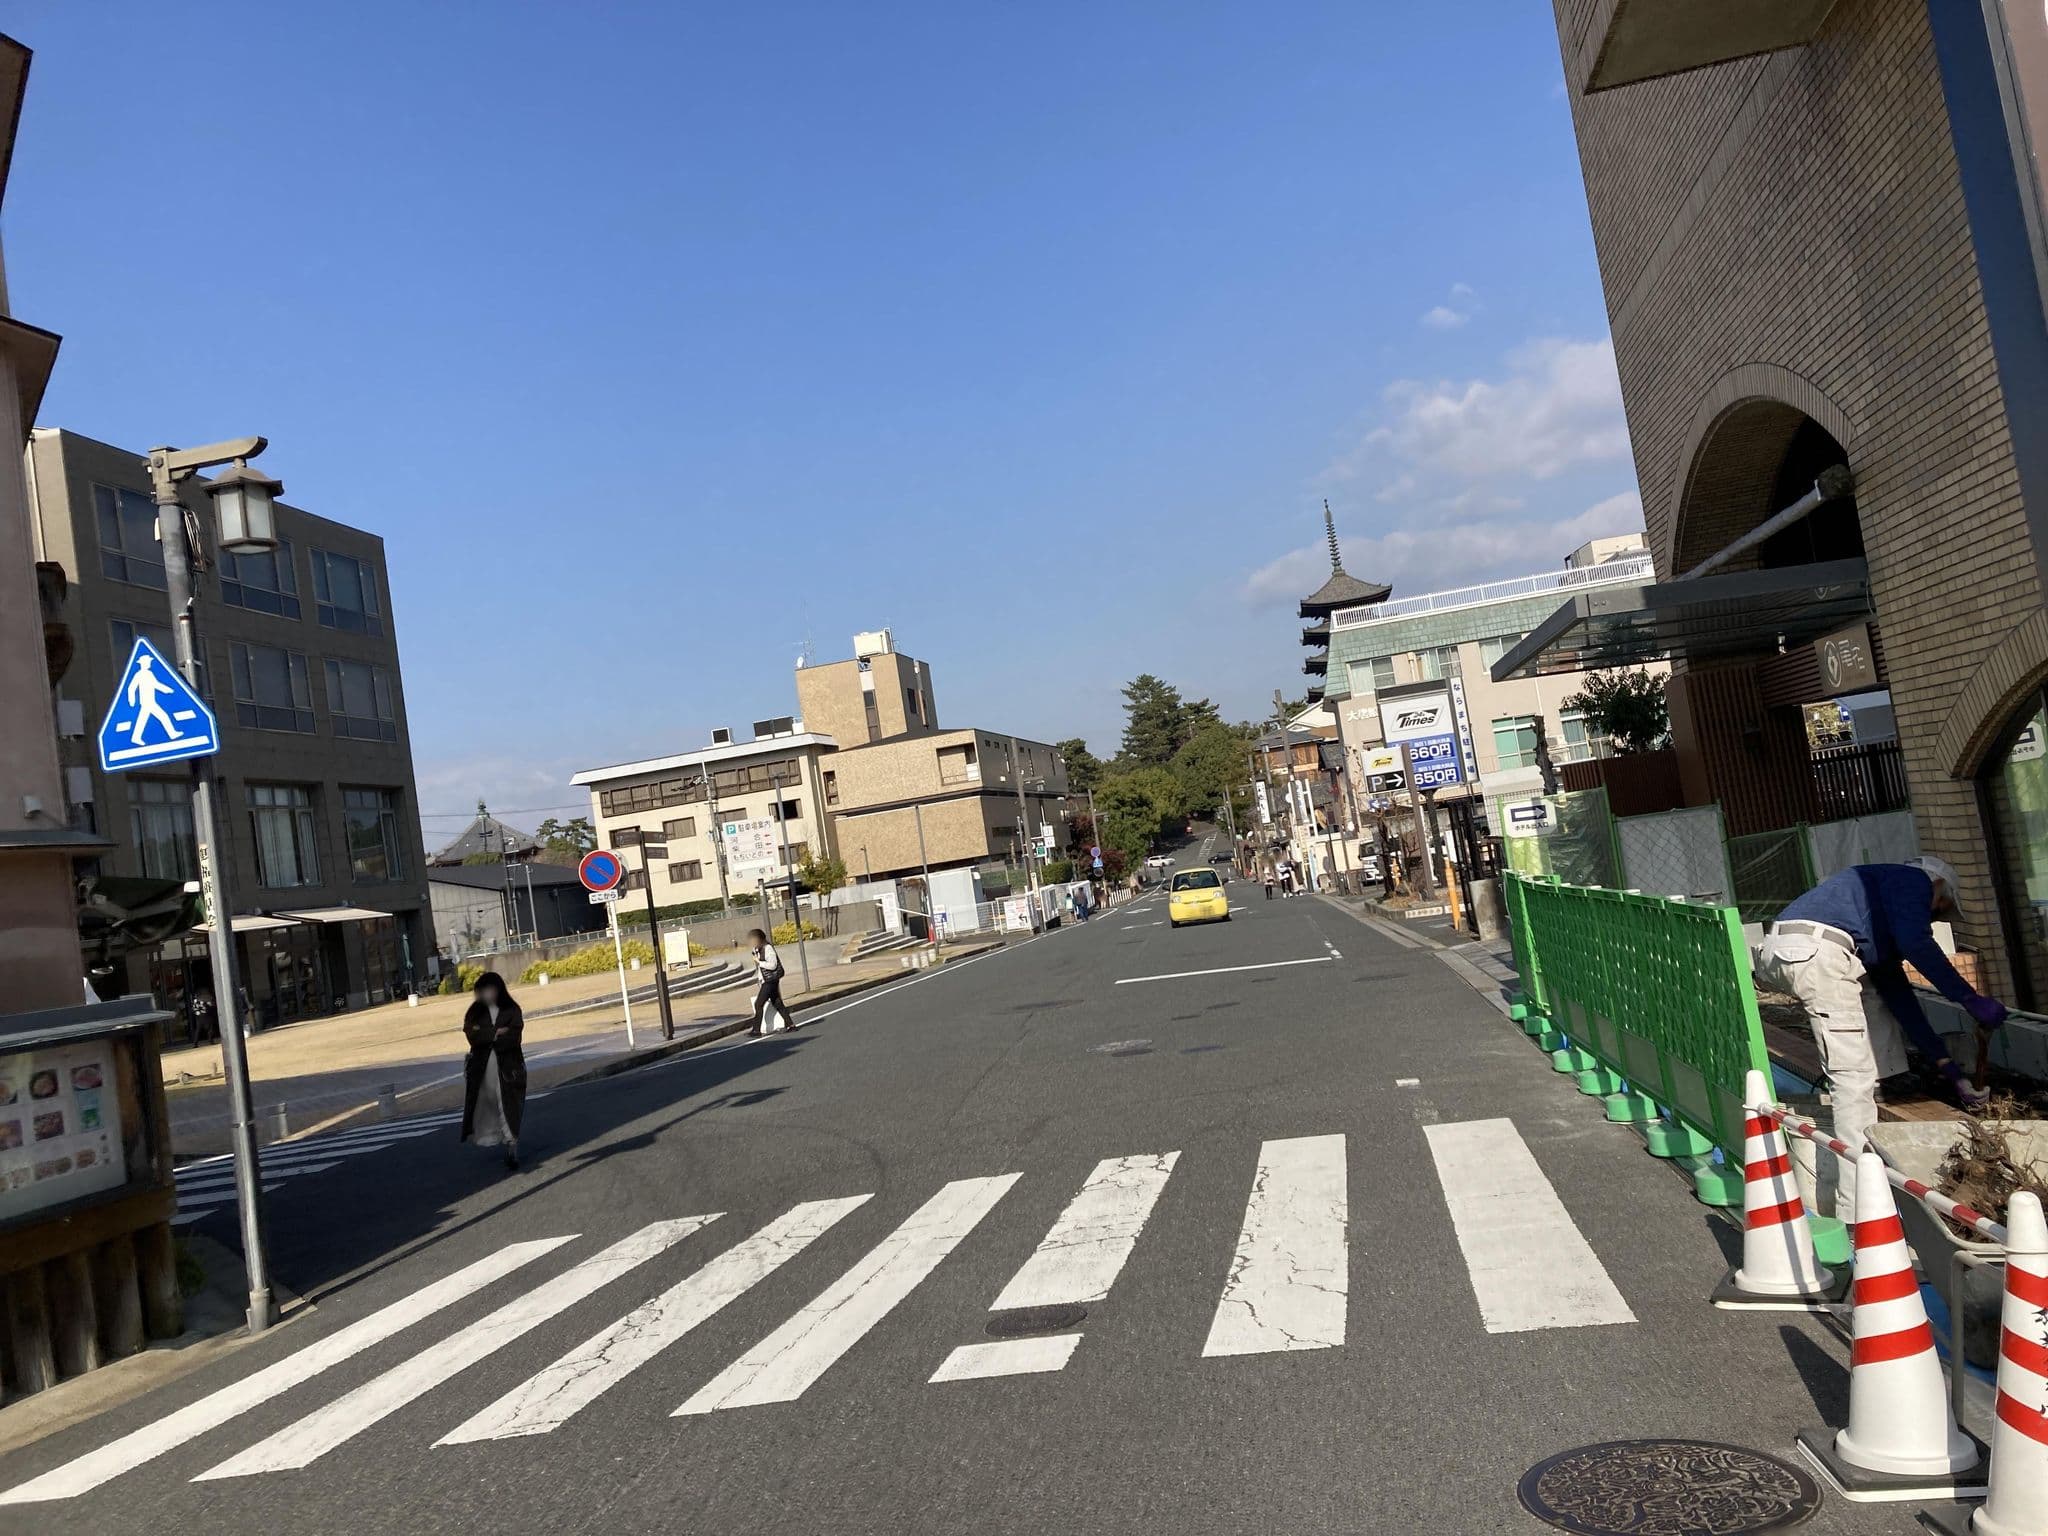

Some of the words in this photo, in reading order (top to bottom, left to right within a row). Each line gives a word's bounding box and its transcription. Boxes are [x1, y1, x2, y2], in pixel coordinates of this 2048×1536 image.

[1397, 710, 1436, 728] Times
[1453, 683, 1475, 773] ならまち駐車場
[1371, 775, 1383, 792] P
[1515, 821, 1549, 831] ホテル出入口
